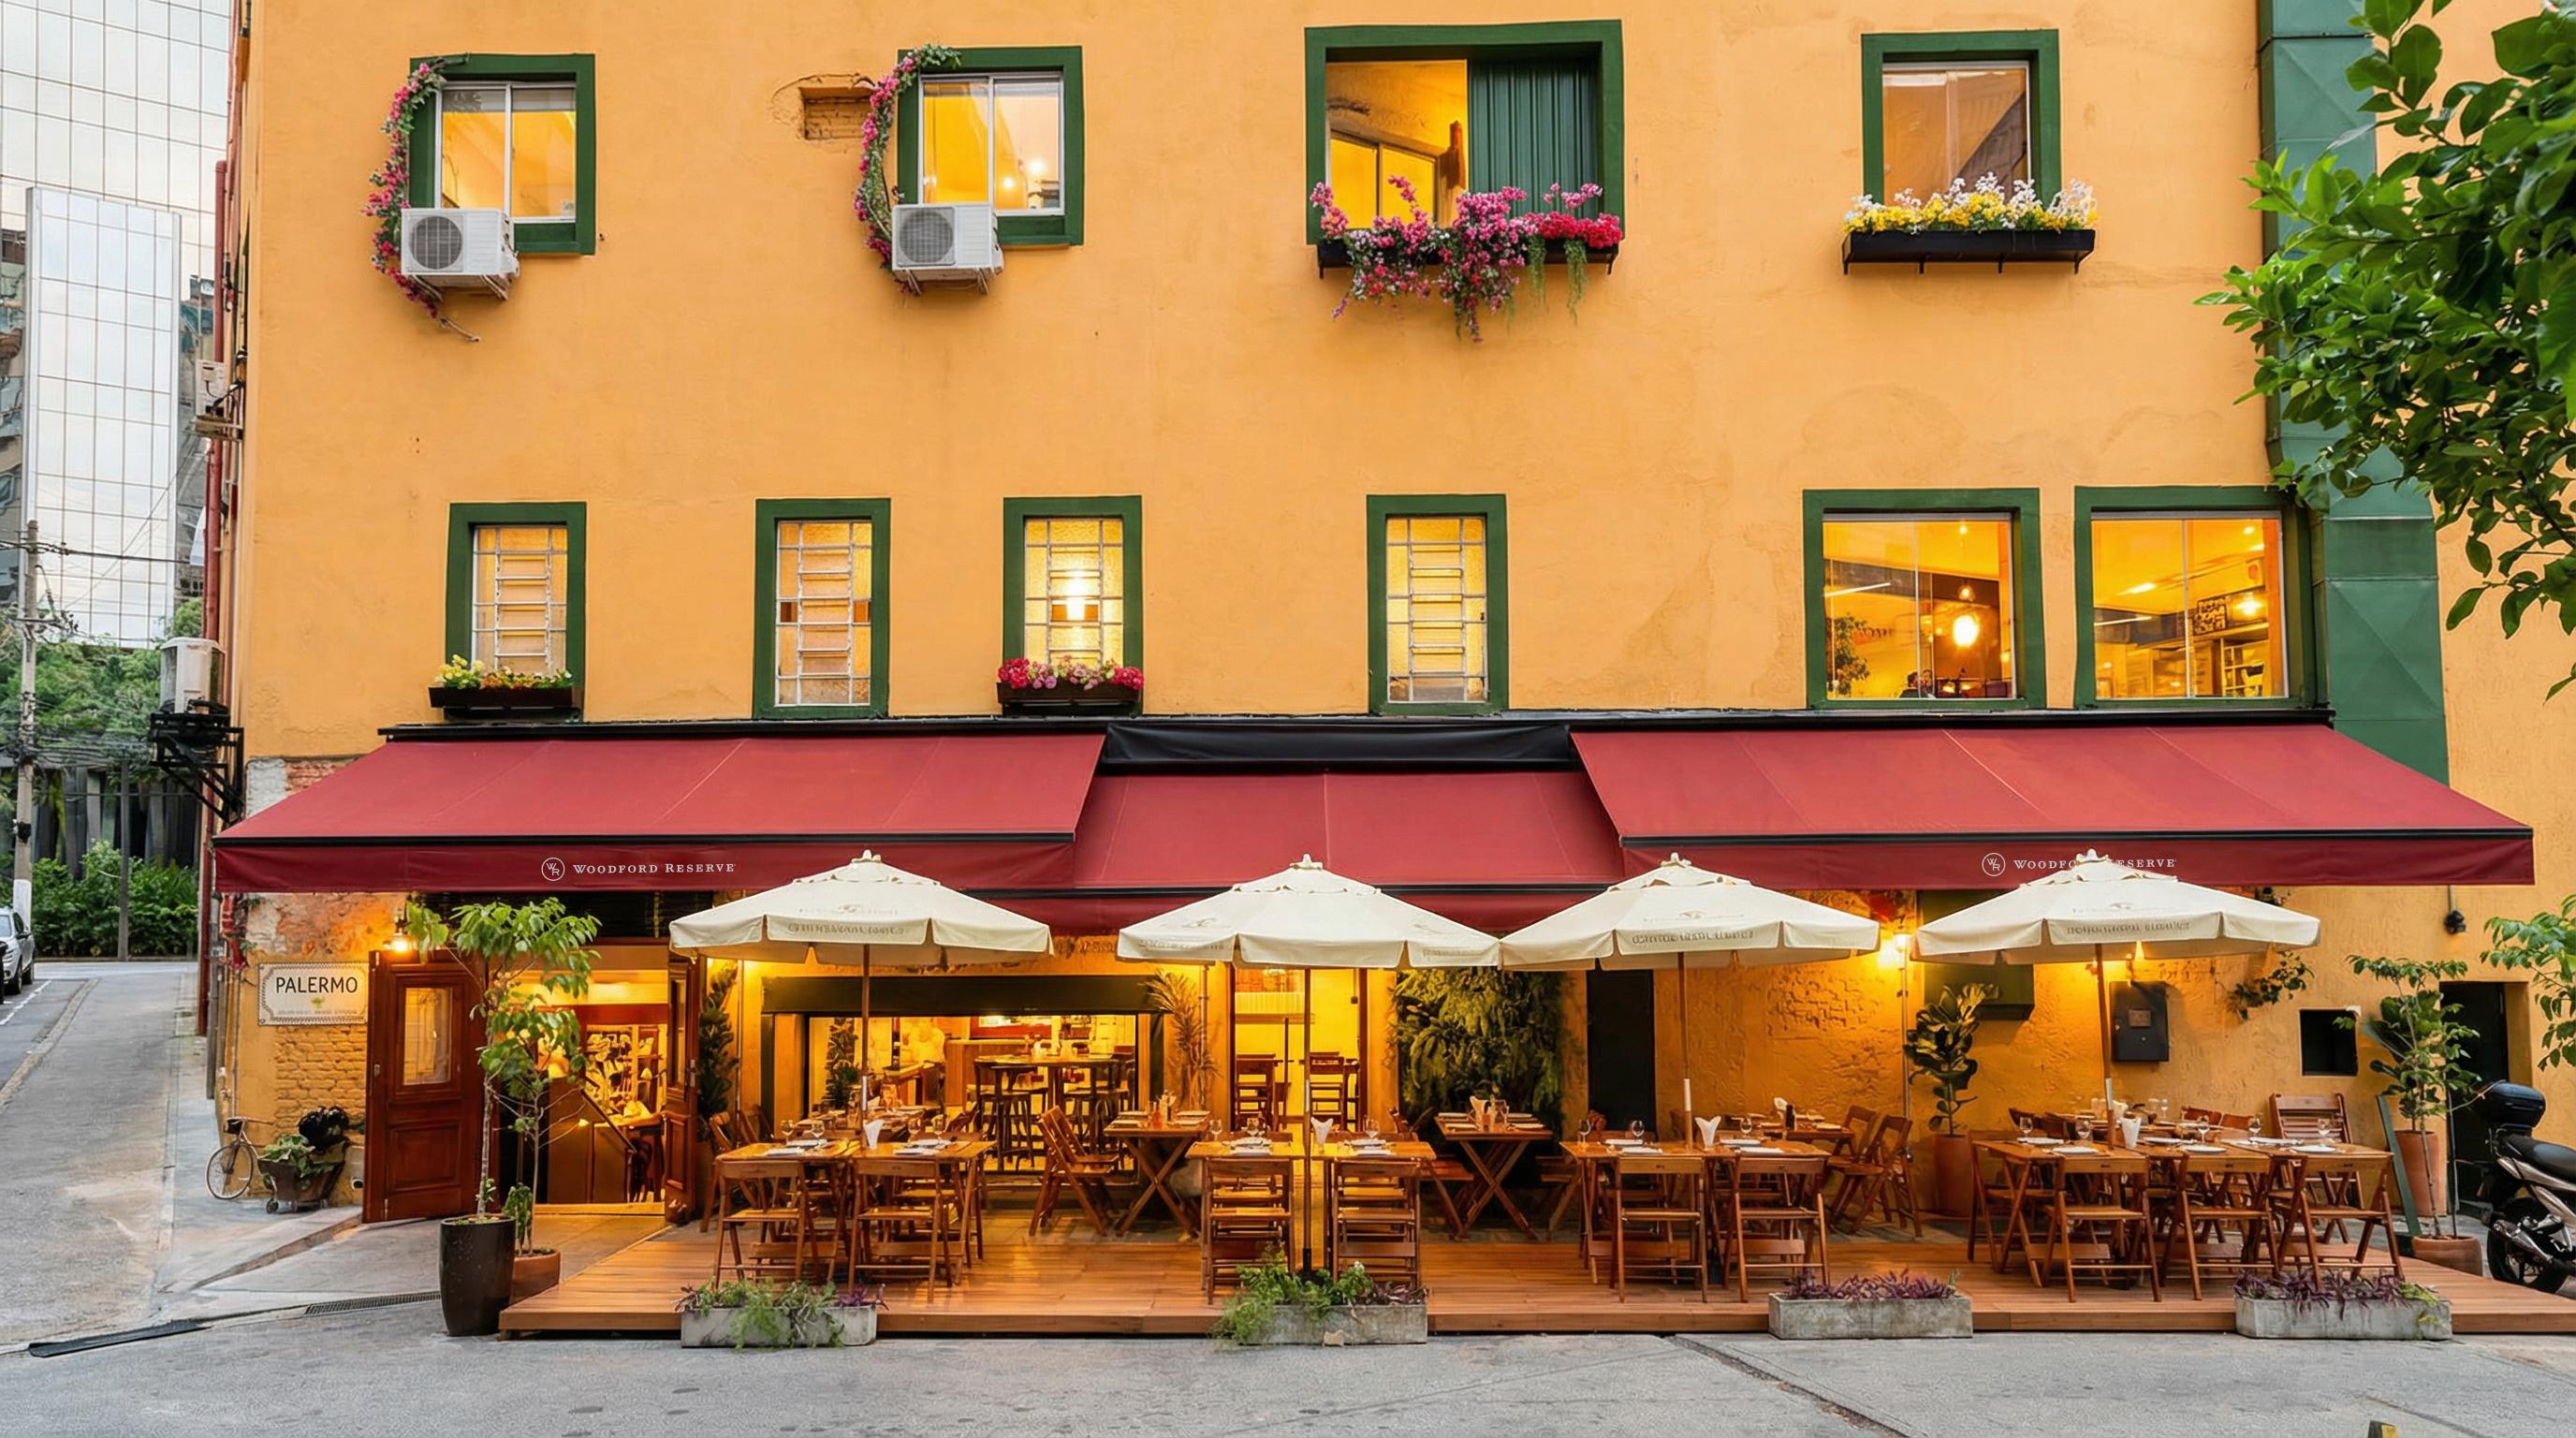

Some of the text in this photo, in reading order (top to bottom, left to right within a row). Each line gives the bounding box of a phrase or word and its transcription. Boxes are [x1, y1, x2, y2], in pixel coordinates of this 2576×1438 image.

[573, 863, 736, 874] WOODFORD RESERVE
[2013, 858, 2175, 870] WOODFO ESERVE
[276, 976, 358, 993] PALERMO
